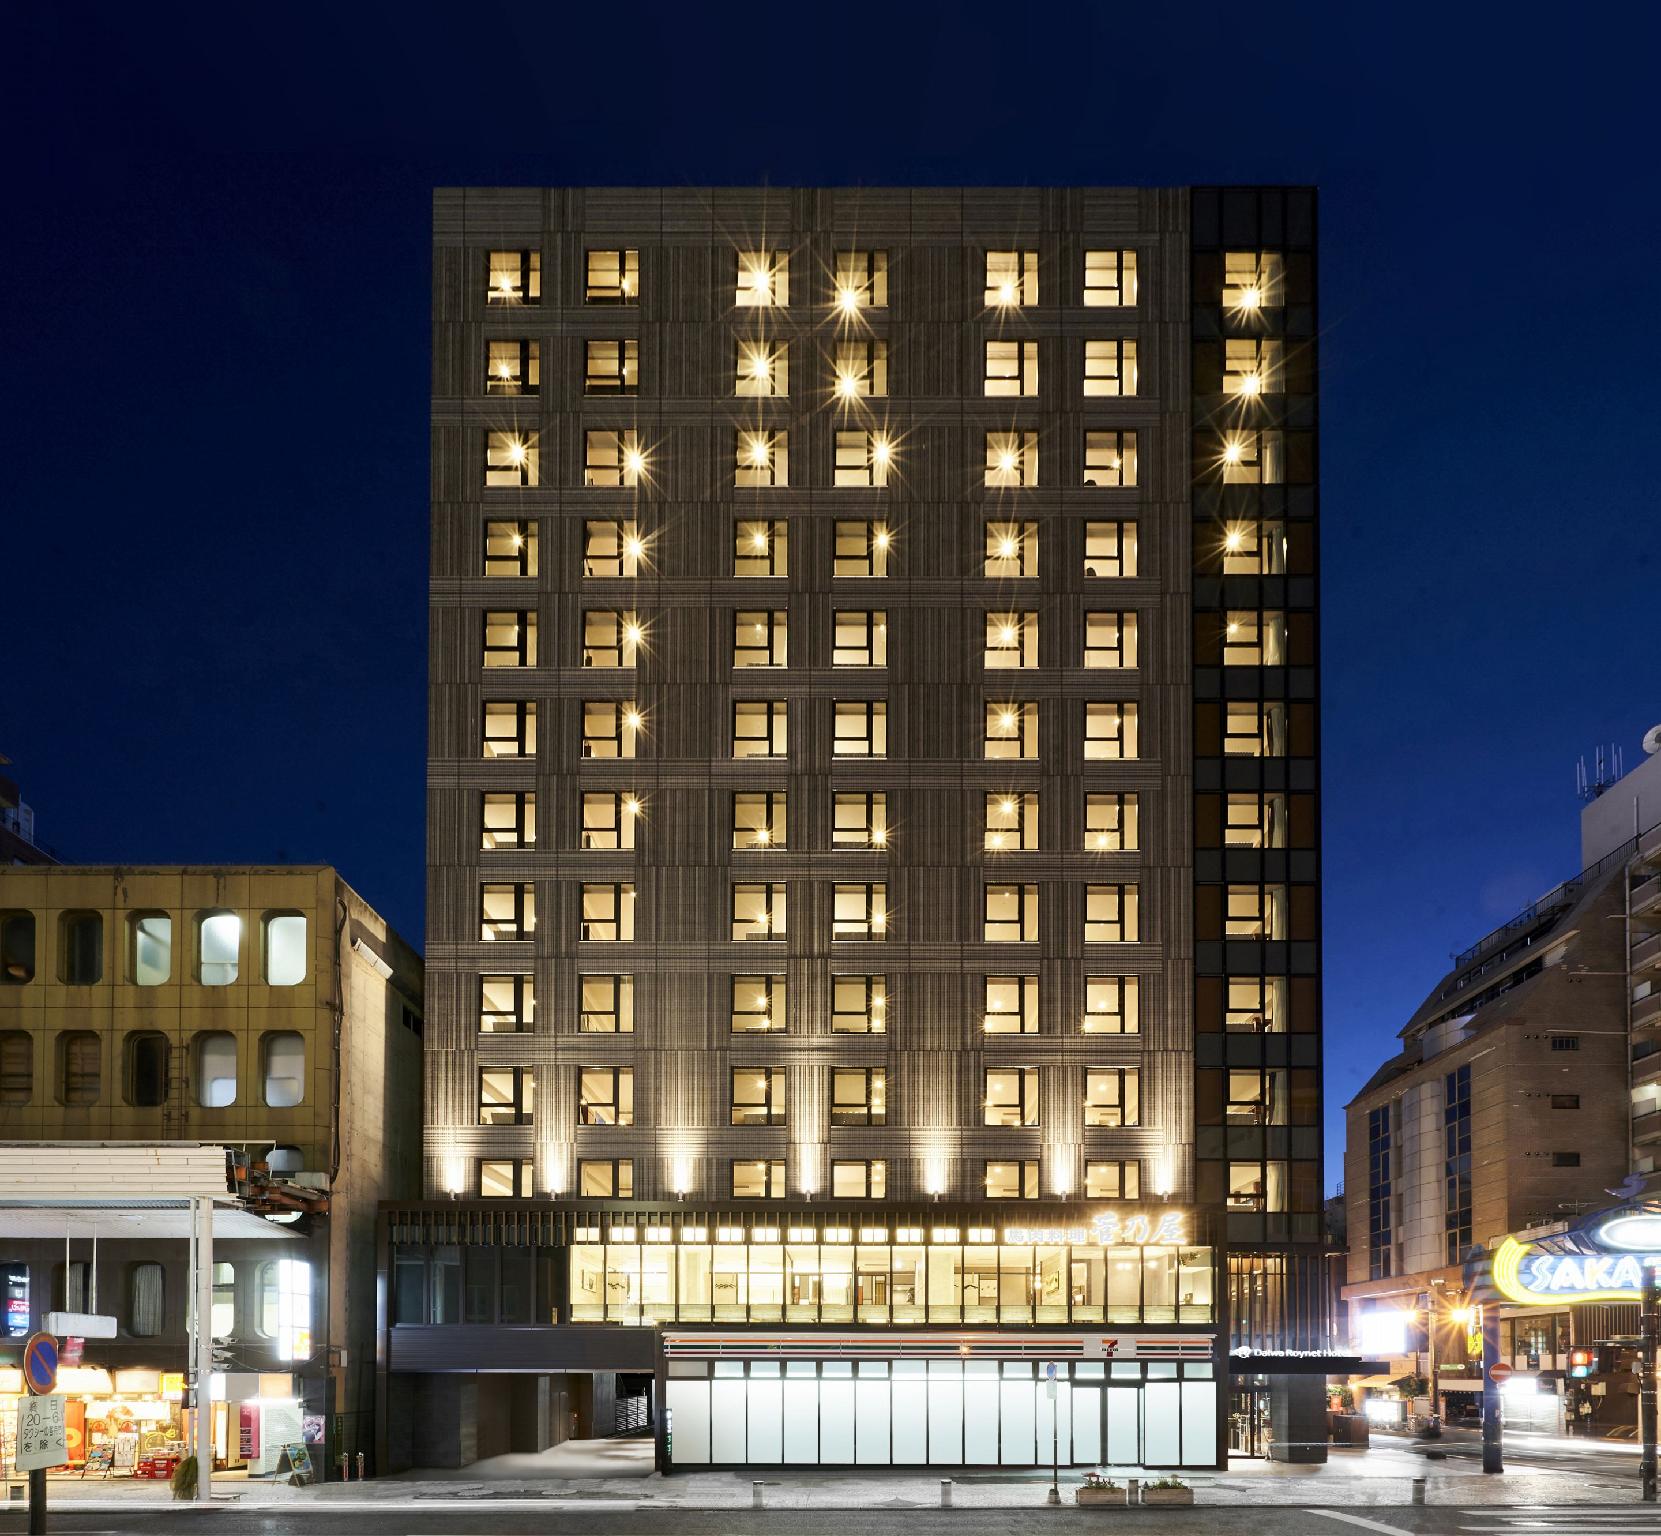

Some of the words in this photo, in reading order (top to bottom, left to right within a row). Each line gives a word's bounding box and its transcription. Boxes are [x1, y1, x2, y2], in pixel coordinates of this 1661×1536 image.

[1092, 1211, 1186, 1245] 菅乃屋
[1253, 1348, 1284, 1357] Daiwa
[1286, 1349, 1322, 1359] Roynet
